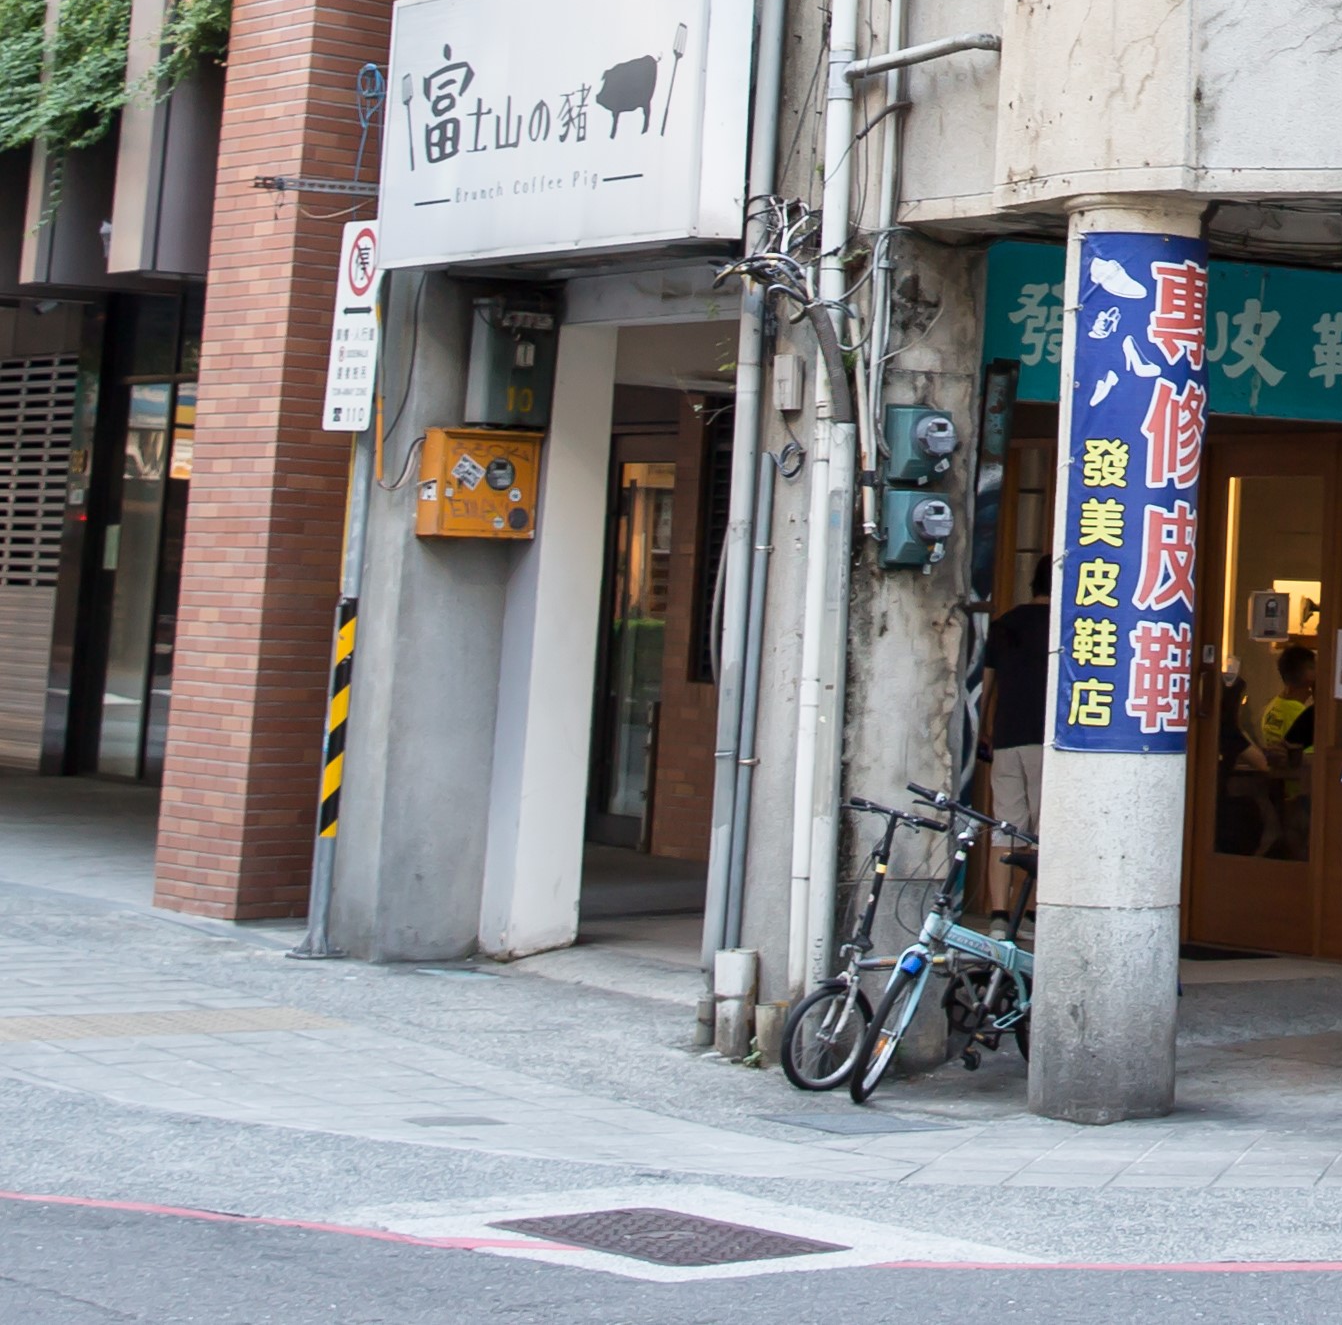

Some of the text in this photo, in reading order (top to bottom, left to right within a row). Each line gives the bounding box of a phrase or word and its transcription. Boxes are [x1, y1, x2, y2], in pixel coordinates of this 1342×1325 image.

[455, 170, 599, 204] Brunch Coffee Pig
[1067, 437, 1130, 728] 發美皮鞋店
